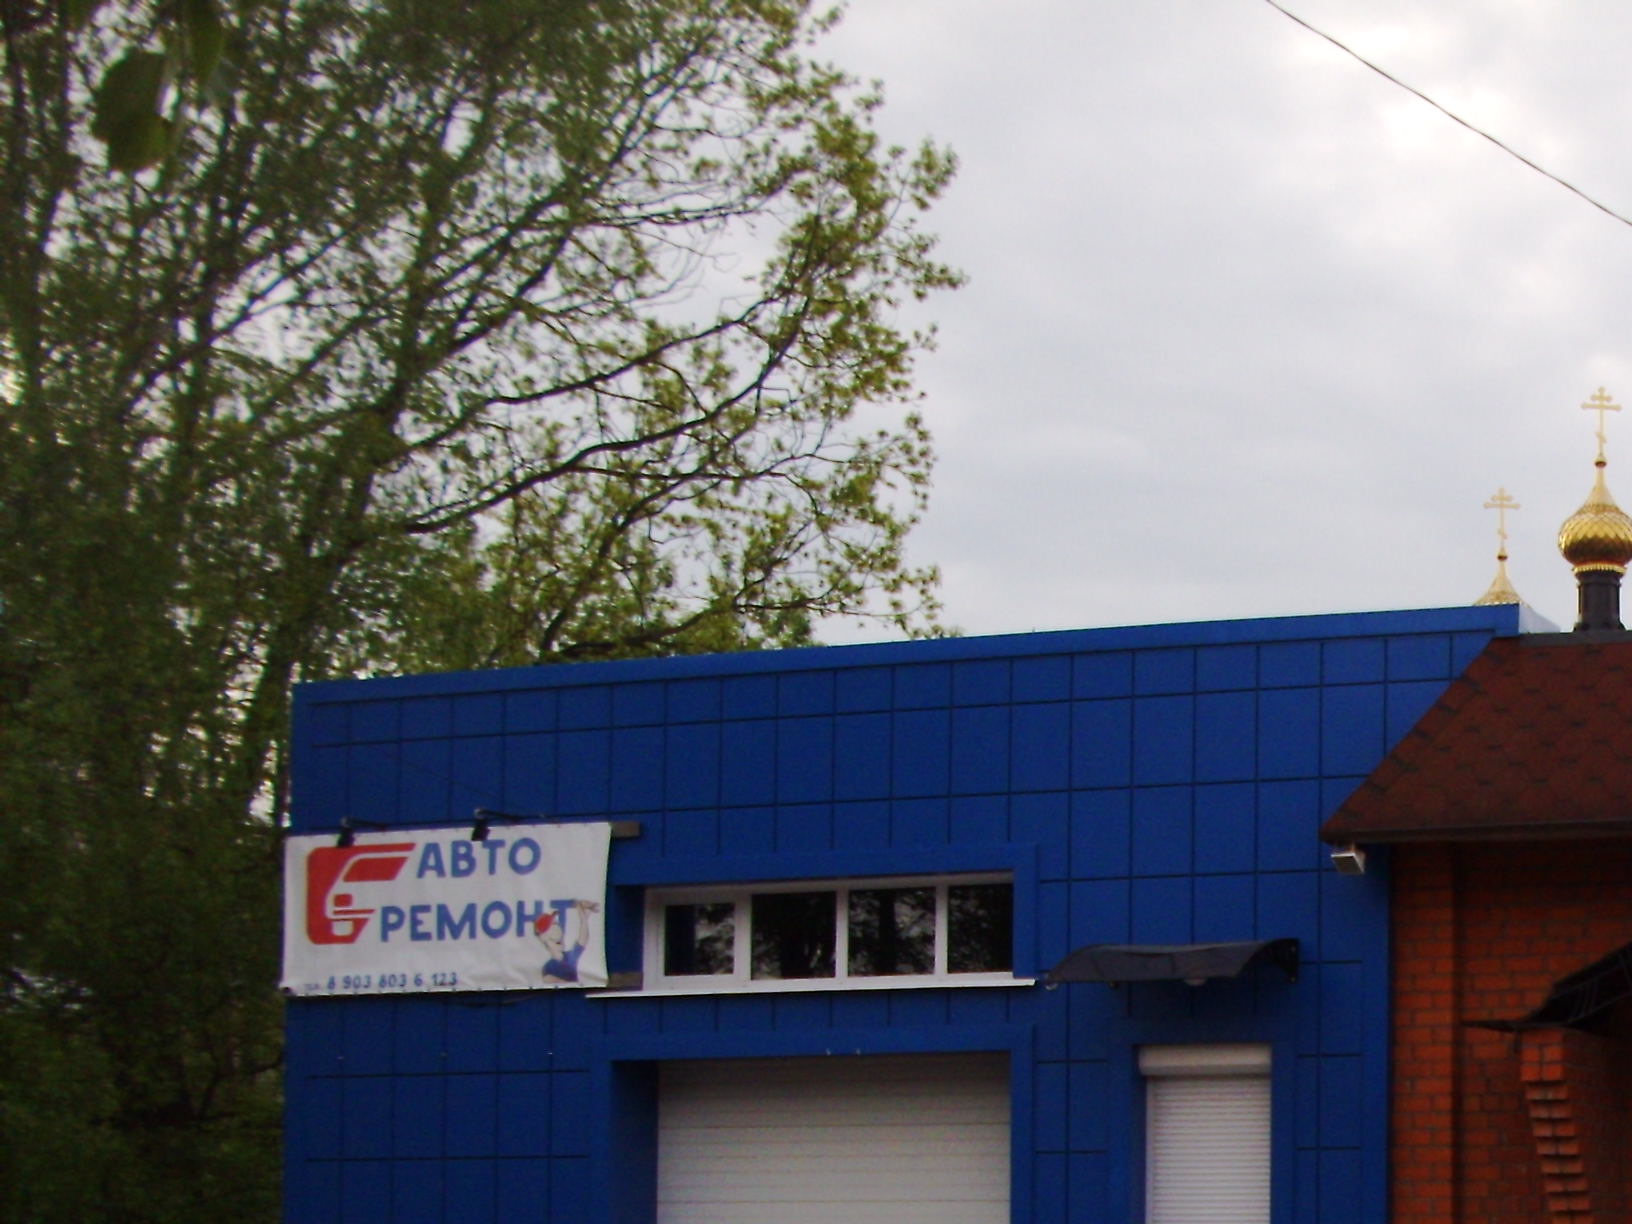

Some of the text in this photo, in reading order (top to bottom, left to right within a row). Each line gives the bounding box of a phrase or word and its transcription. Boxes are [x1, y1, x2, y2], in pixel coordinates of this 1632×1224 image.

[417, 837, 542, 878] АВТО
[380, 899, 577, 942] РЕМОНТ
[342, 975, 372, 989] 903
[414, 973, 424, 986] 6
[432, 972, 458, 986] 123
